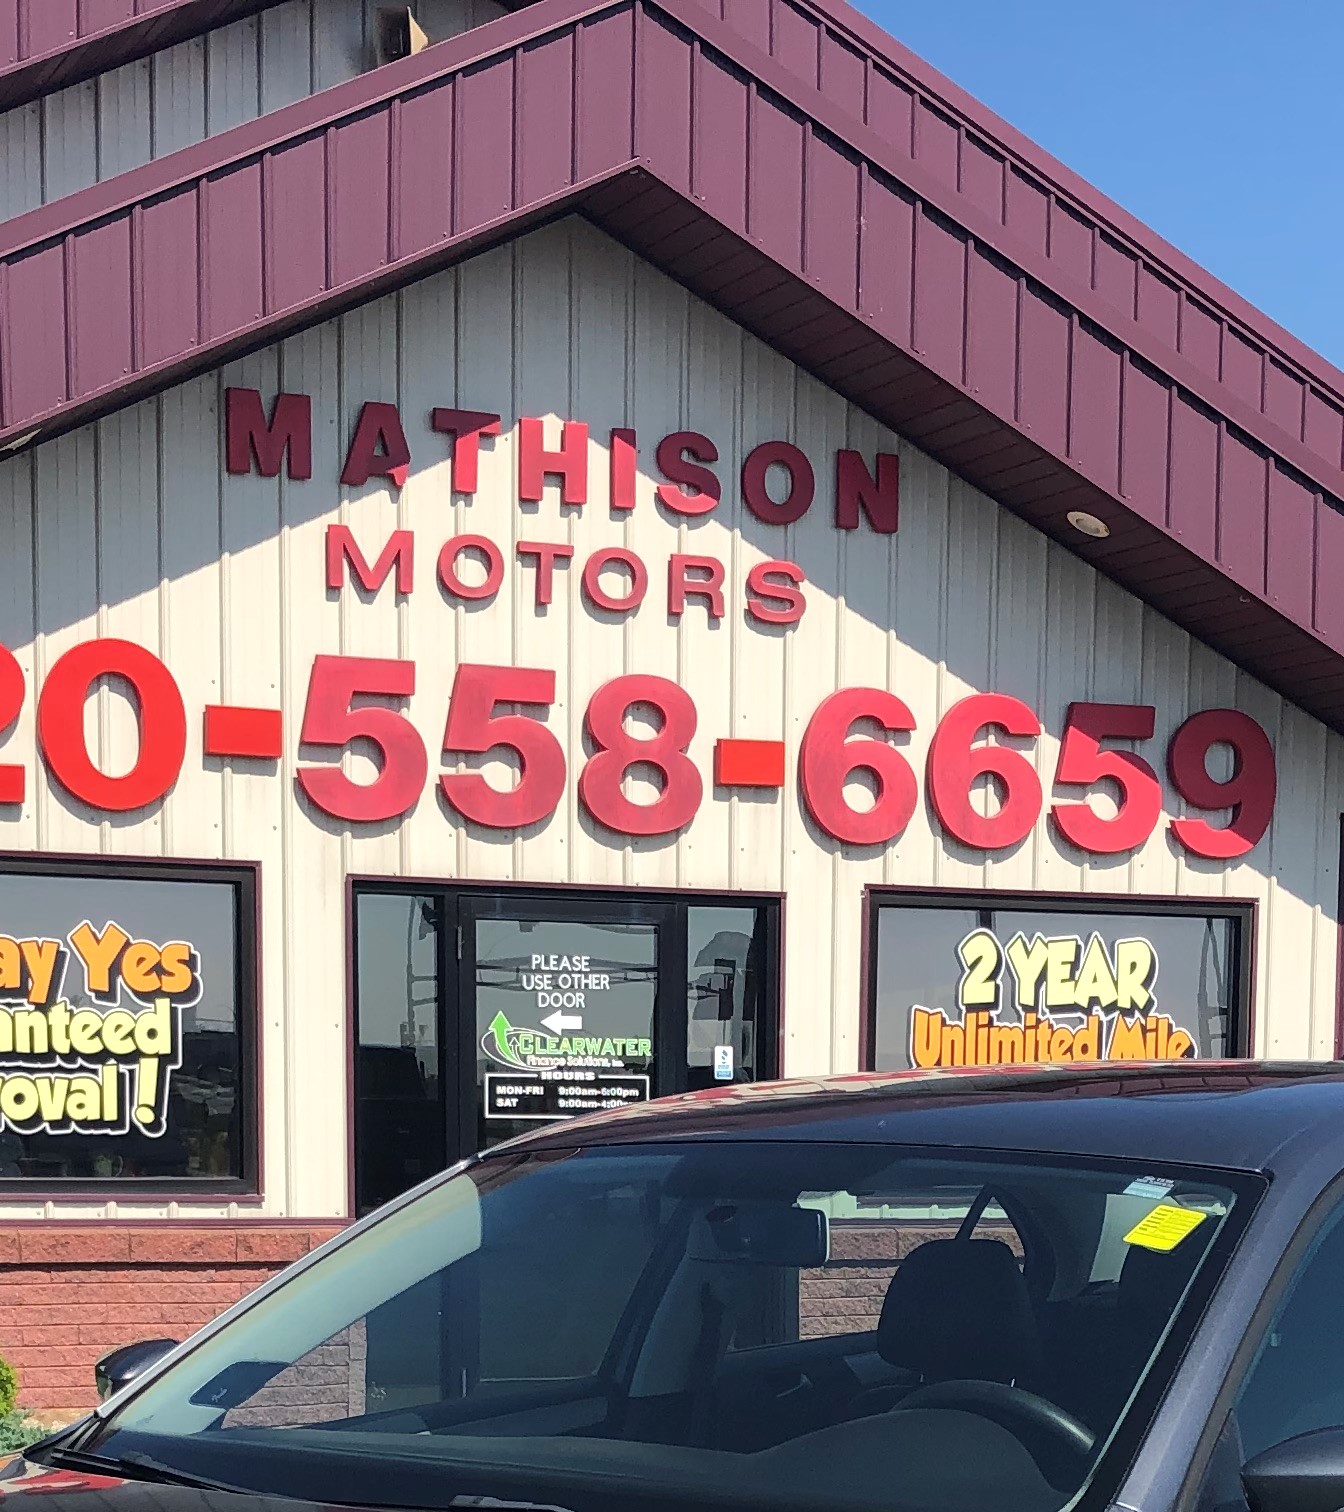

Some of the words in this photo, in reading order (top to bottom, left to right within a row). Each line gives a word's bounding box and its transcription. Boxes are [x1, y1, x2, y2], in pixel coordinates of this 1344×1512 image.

[224, 386, 900, 534] MATHISON
[325, 523, 808, 624] MOTORS
[69, 920, 198, 995] Yes
[531, 954, 591, 972] PLEASE
[959, 931, 1001, 1006] 2
[1007, 933, 1153, 1010] YEAR
[522, 973, 553, 990] USE
[558, 973, 610, 990] OTHER
[537, 992, 586, 1008] DOOR
[519, 1033, 653, 1057] CLEARWATER
[914, 1008, 1101, 1068] Unlimited
[540, 1071, 596, 1081] HOURS
[495, 1085, 545, 1096] MON-FRI
[495, 1098, 519, 1108] SAT
